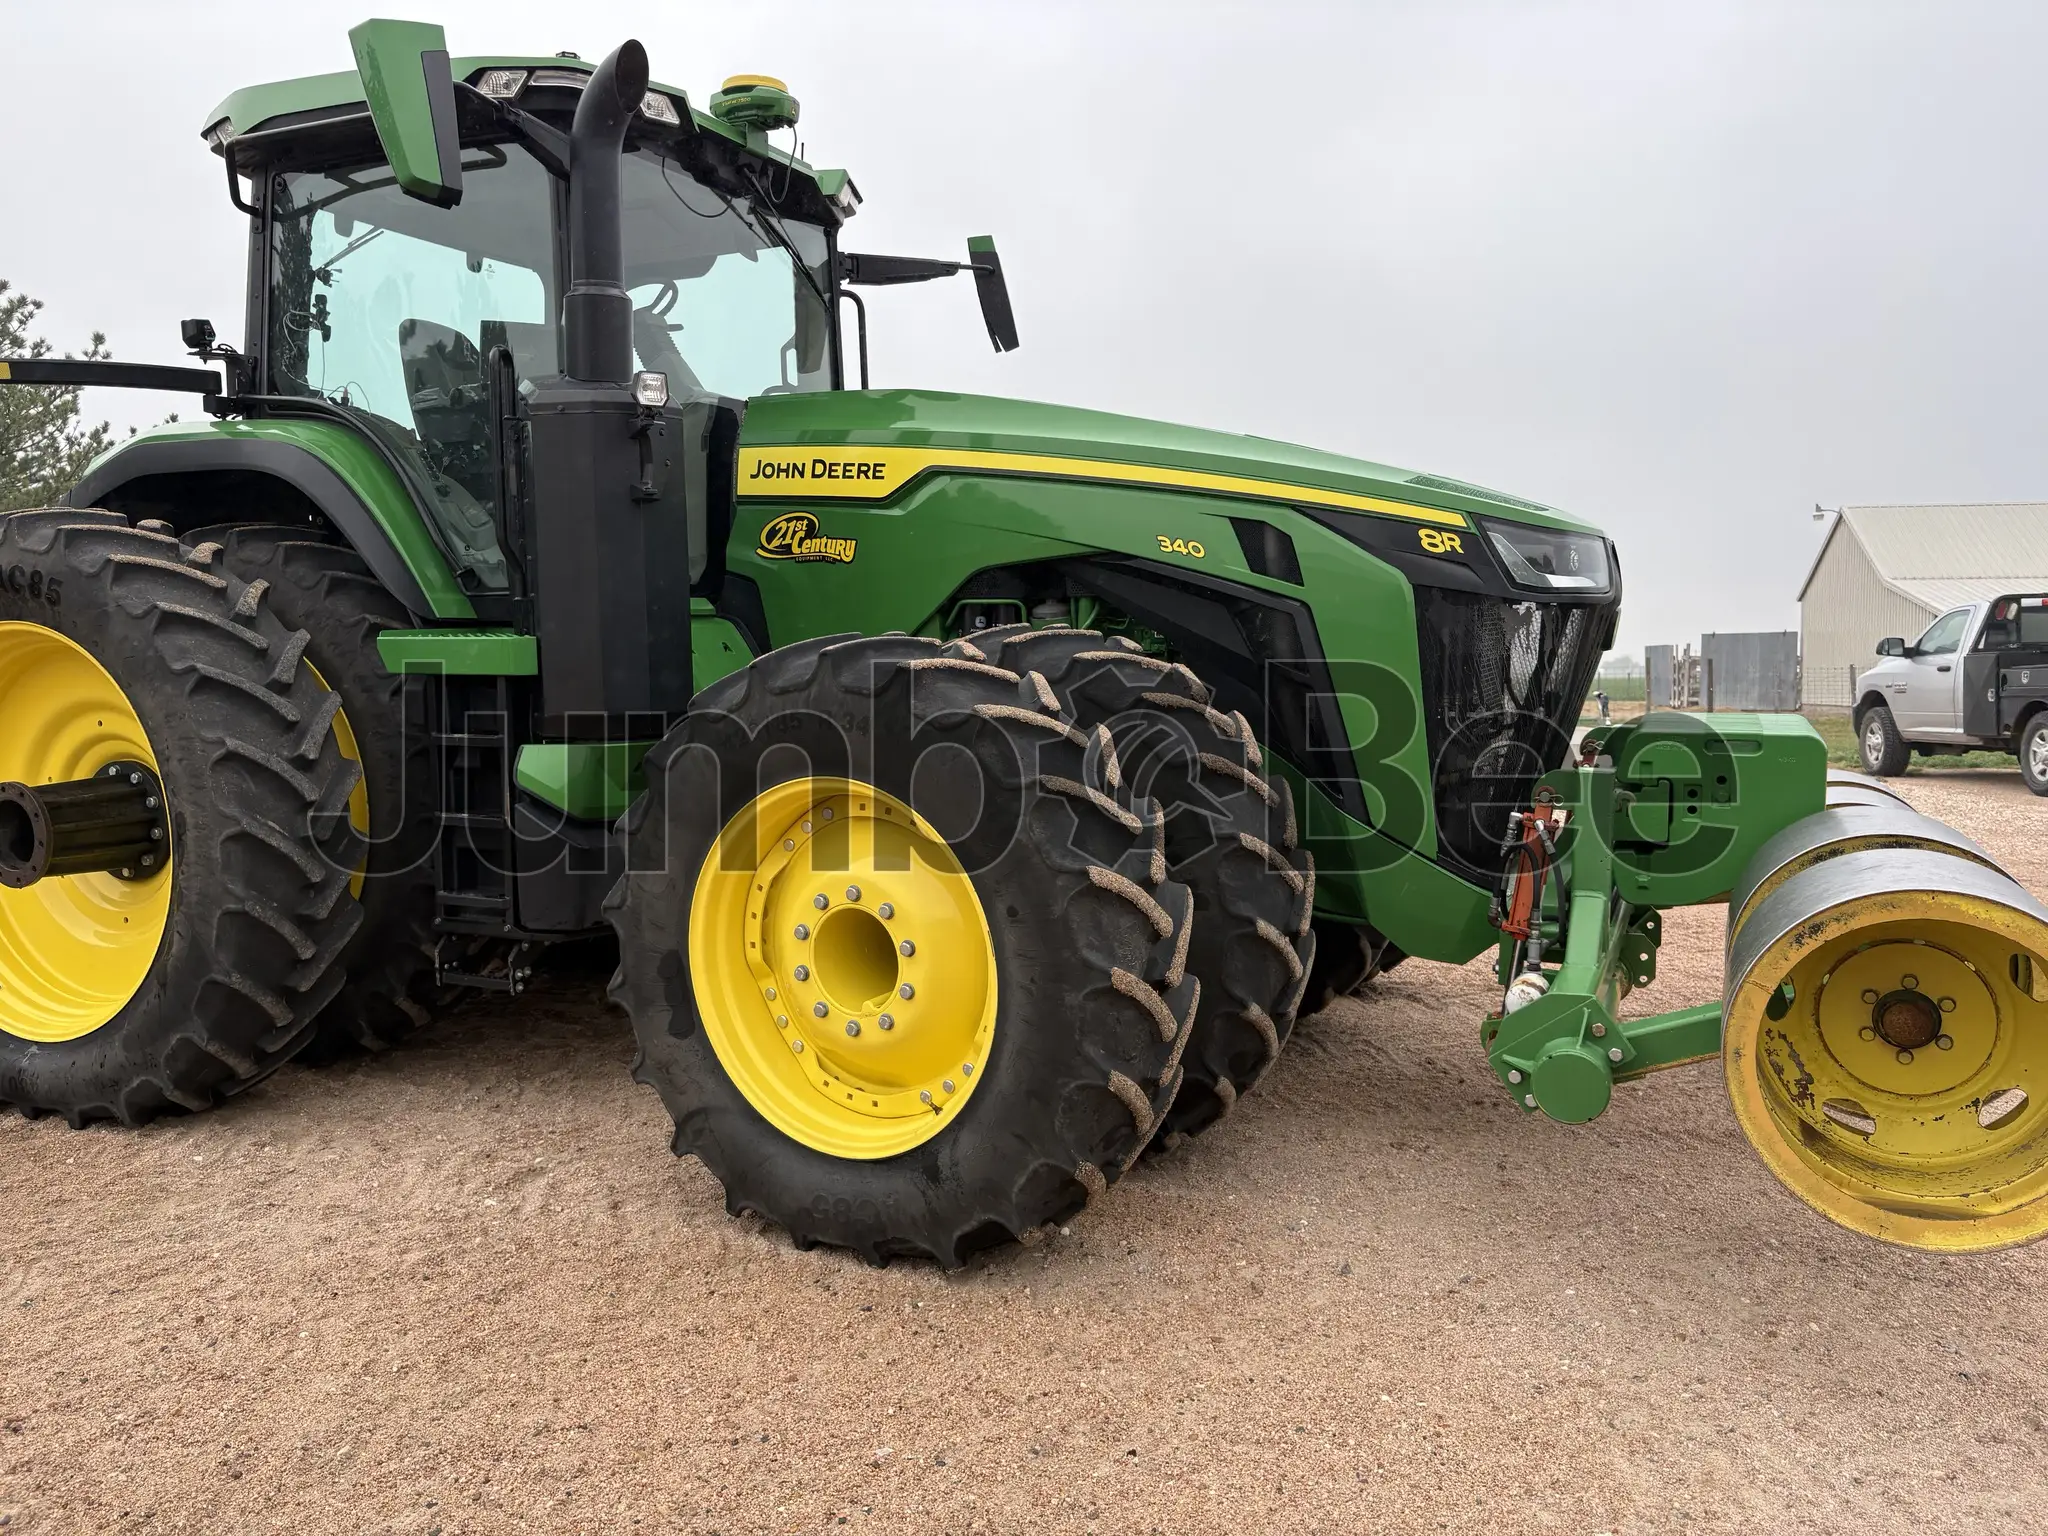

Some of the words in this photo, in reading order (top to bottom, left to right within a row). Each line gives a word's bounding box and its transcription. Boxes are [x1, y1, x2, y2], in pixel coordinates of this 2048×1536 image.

[750, 459, 806, 480] JOHN
[811, 459, 886, 480] DEERE
[769, 518, 808, 548] 21st
[1417, 528, 1465, 554] 8R
[1156, 535, 1207, 559] 340
